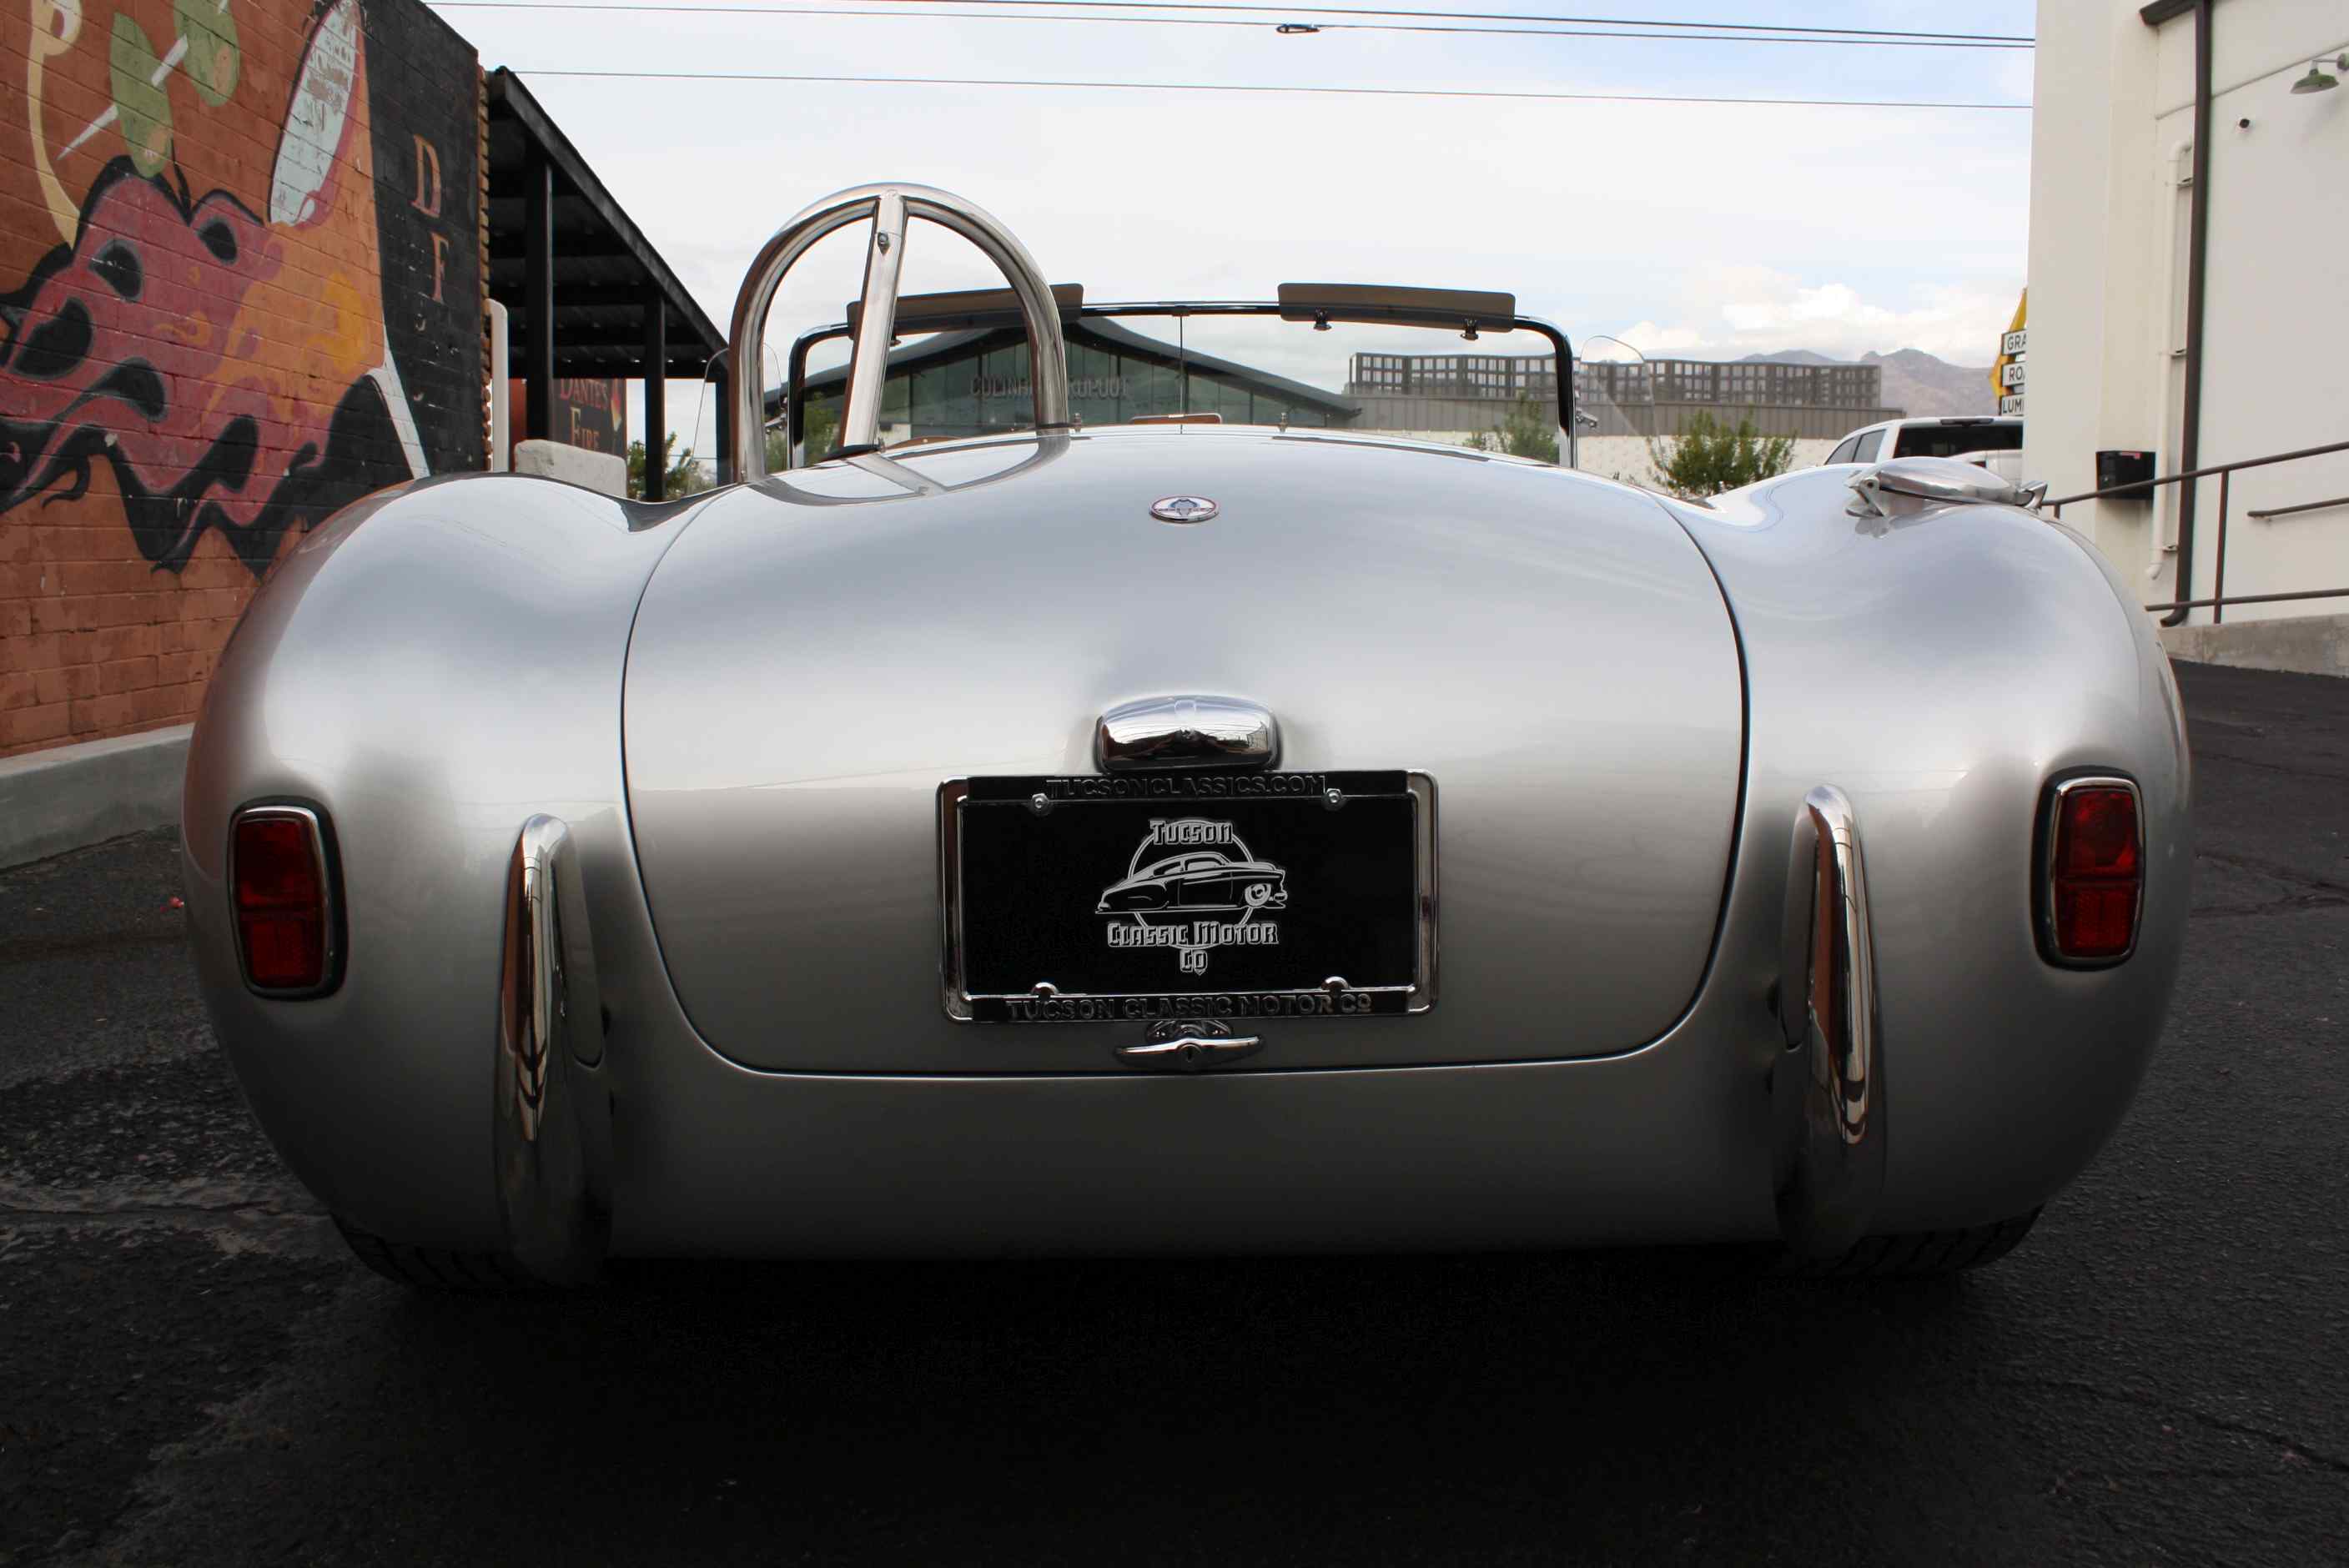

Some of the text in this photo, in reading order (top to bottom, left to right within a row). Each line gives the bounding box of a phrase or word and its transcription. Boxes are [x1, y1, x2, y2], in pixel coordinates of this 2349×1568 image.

[411, 134, 441, 219] D
[430, 231, 450, 304] F
[2009, 365, 2025, 382] RO
[1046, 775, 1326, 797] TUCSONCLASSICS.COM
[1006, 993, 1372, 1019] TUCSON CLASSIC MOTOR CO
